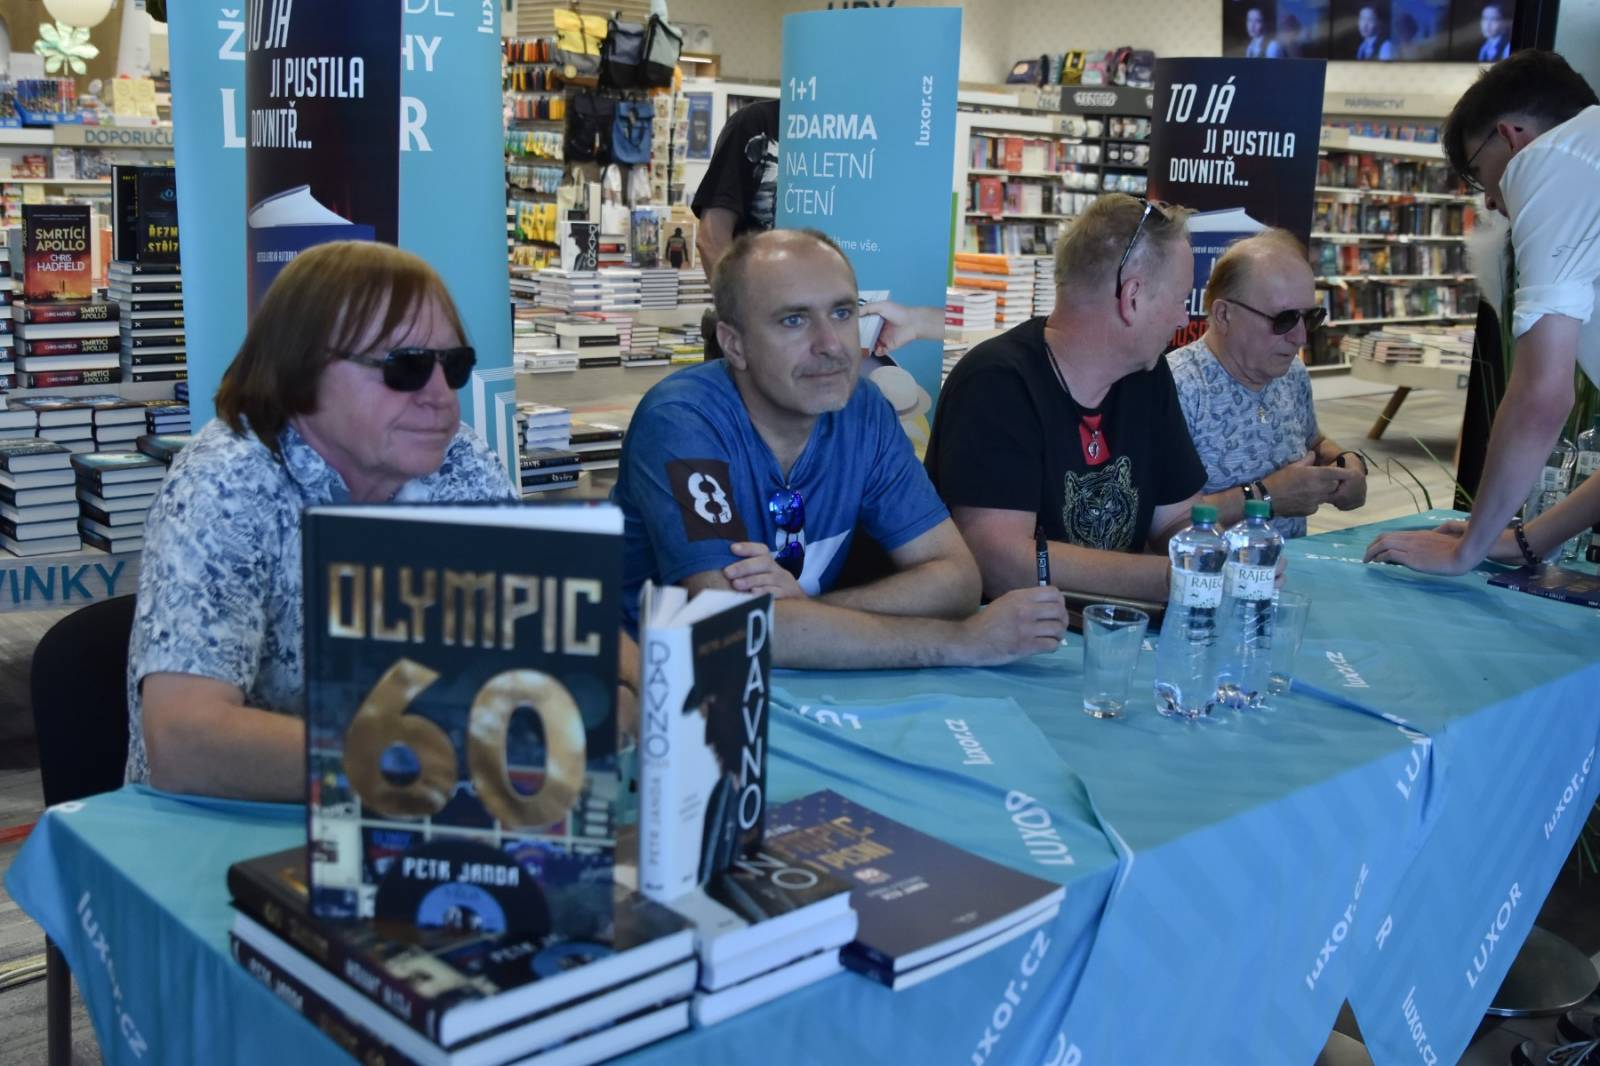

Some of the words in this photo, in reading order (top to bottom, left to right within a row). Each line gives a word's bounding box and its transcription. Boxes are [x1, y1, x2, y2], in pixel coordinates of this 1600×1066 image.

[270, 58, 281, 98] JI
[284, 56, 364, 98] PUSTILA
[789, 76, 817, 102] 1+1
[914, 75, 934, 146] luxor.cz
[1165, 83, 1198, 123] TO
[1197, 75, 1236, 124] JÁ
[786, 113, 878, 141] ZDARMA
[1203, 129, 1217, 154] JI
[1221, 129, 1296, 158] PUSTILA
[785, 151, 808, 177] NA
[813, 148, 876, 180] LETNÍ
[1169, 156, 1249, 187] DOVNITŘ...
[784, 183, 836, 216] ČTENÍ
[35, 226, 86, 240] SMRTÍCÍ
[36, 240, 86, 251] APOLLO
[587, 224, 598, 268] DAVNO
[859, 240, 881, 252] vše.
[37, 262, 85, 272] HADFIELD
[50, 254, 72, 262] CHRIS
[688, 472, 732, 523] 8
[1191, 577, 1222, 591] RAJEC
[1239, 568, 1273, 583] RAJEC
[328, 562, 603, 657] OLYMPIC
[648, 640, 671, 759] DAVNO
[738, 608, 767, 831] DAVNO
[344, 657, 587, 829] 60
[944, 718, 994, 766] luxor.cz
[1005, 789, 1075, 866] LUXOR
[402, 857, 451, 880] PETR
[457, 862, 520, 887] JANDA
[1305, 863, 1369, 991] luxor.cz
[1465, 882, 1523, 990] LUXOR
